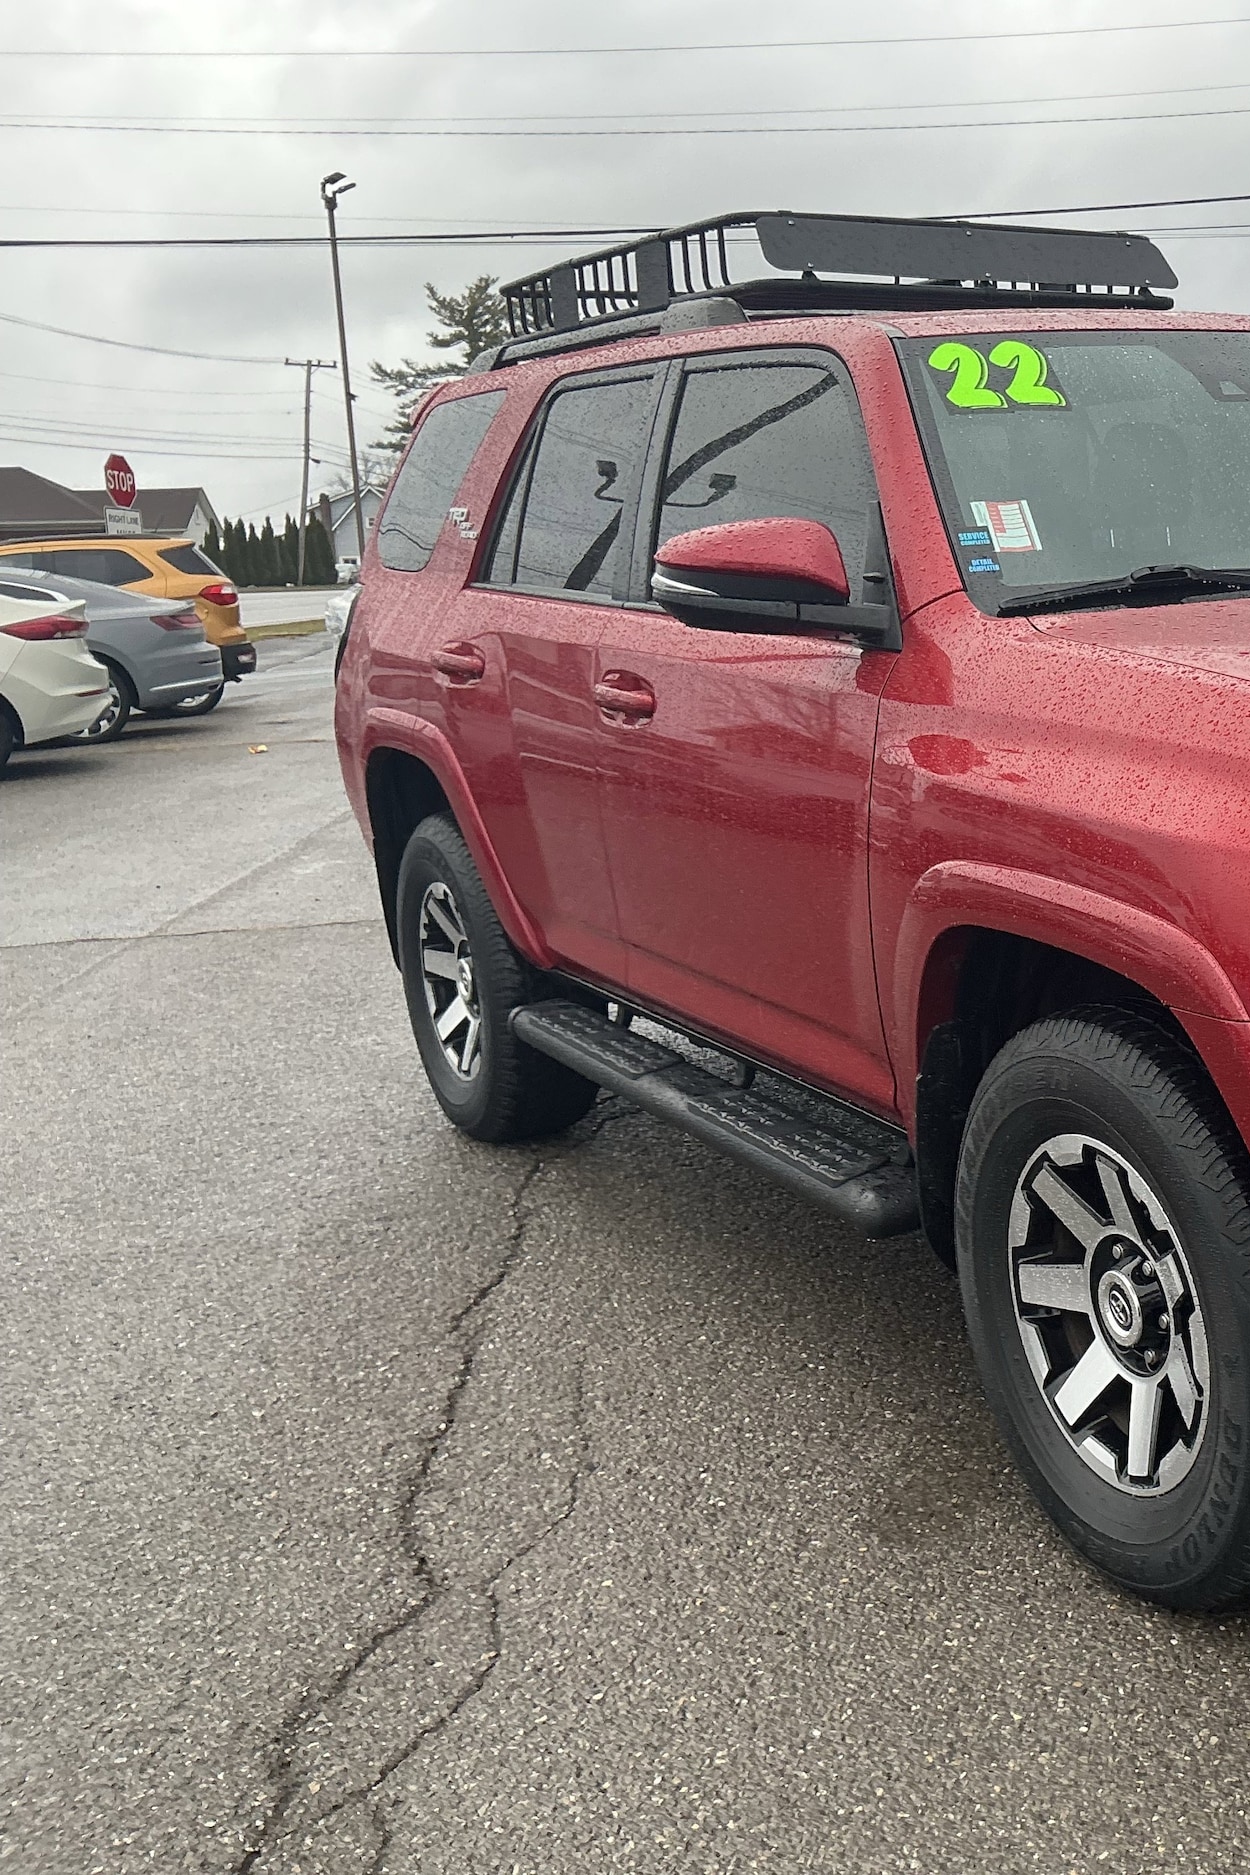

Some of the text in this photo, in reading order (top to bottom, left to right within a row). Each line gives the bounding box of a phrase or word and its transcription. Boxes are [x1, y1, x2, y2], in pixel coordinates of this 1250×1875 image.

[928, 340, 1067, 409] 22
[107, 469, 133, 493] STOP
[958, 531, 989, 541] SERVICE
[971, 558, 993, 566] DETAIL
[968, 564, 1000, 573] COMPLETED
